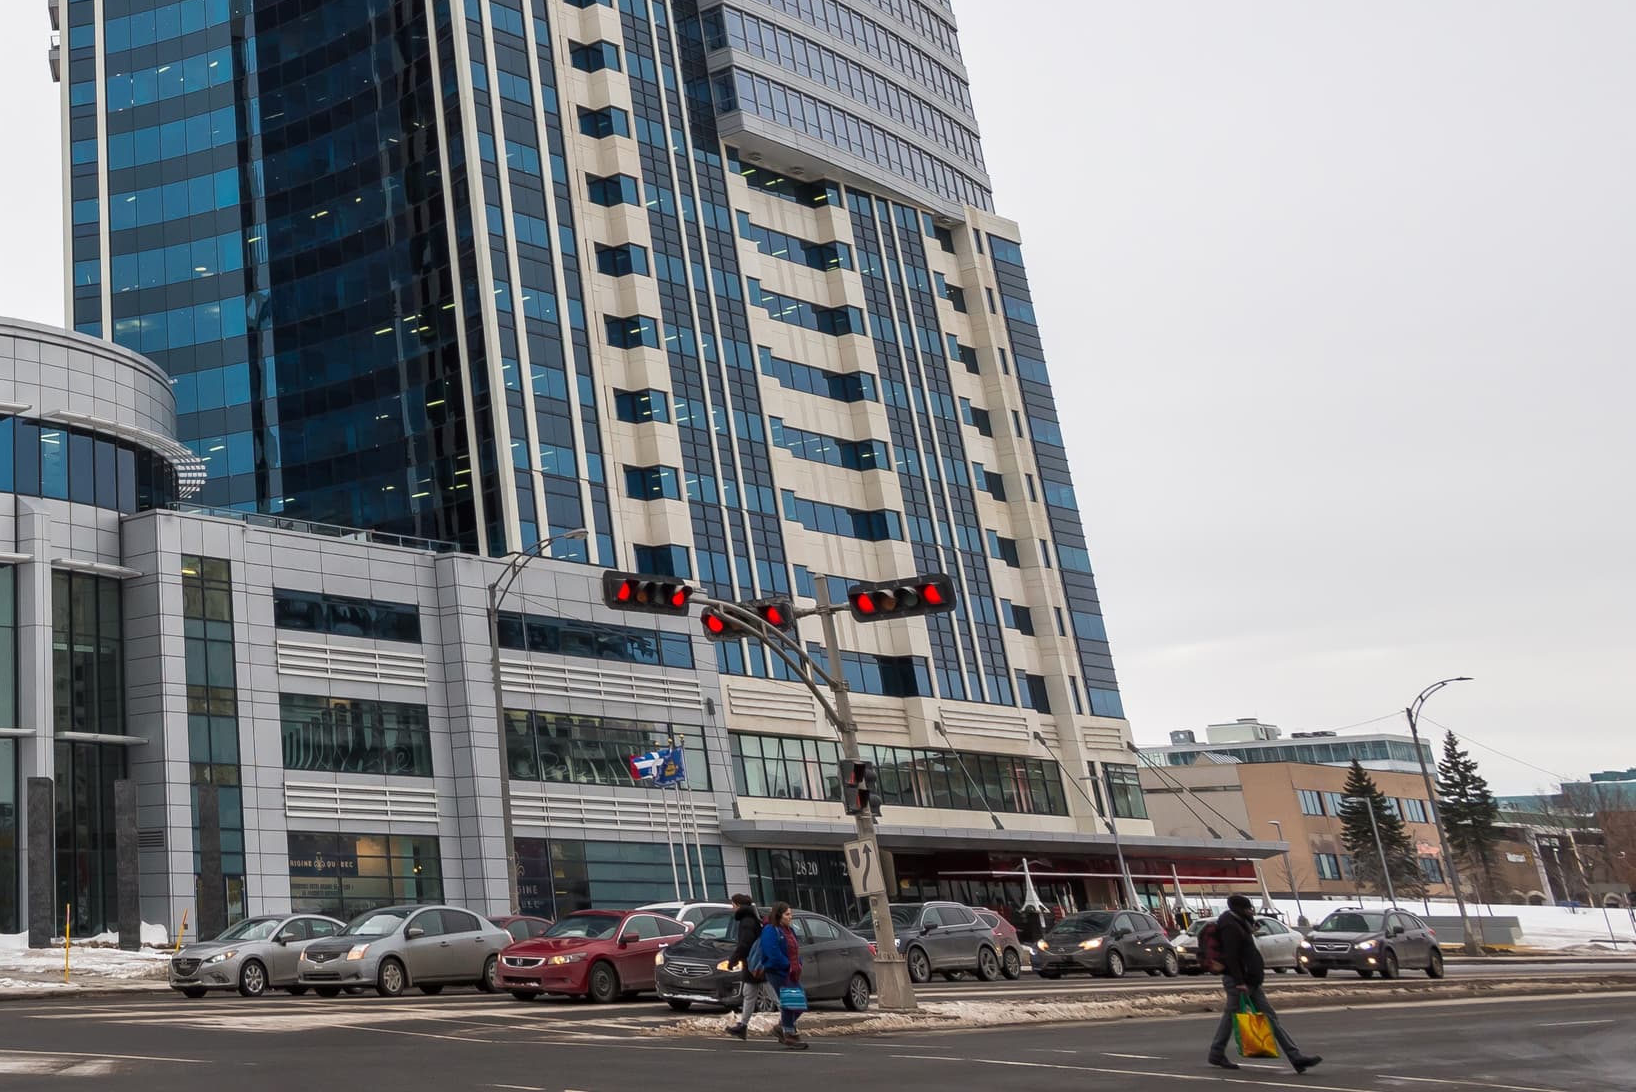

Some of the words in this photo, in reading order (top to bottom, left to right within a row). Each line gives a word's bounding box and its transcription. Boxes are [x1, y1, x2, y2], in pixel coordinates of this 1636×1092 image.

[289, 859, 313, 868] RIGINE
[326, 860, 354, 868] QUBEC
[795, 860, 819, 876] 2820
